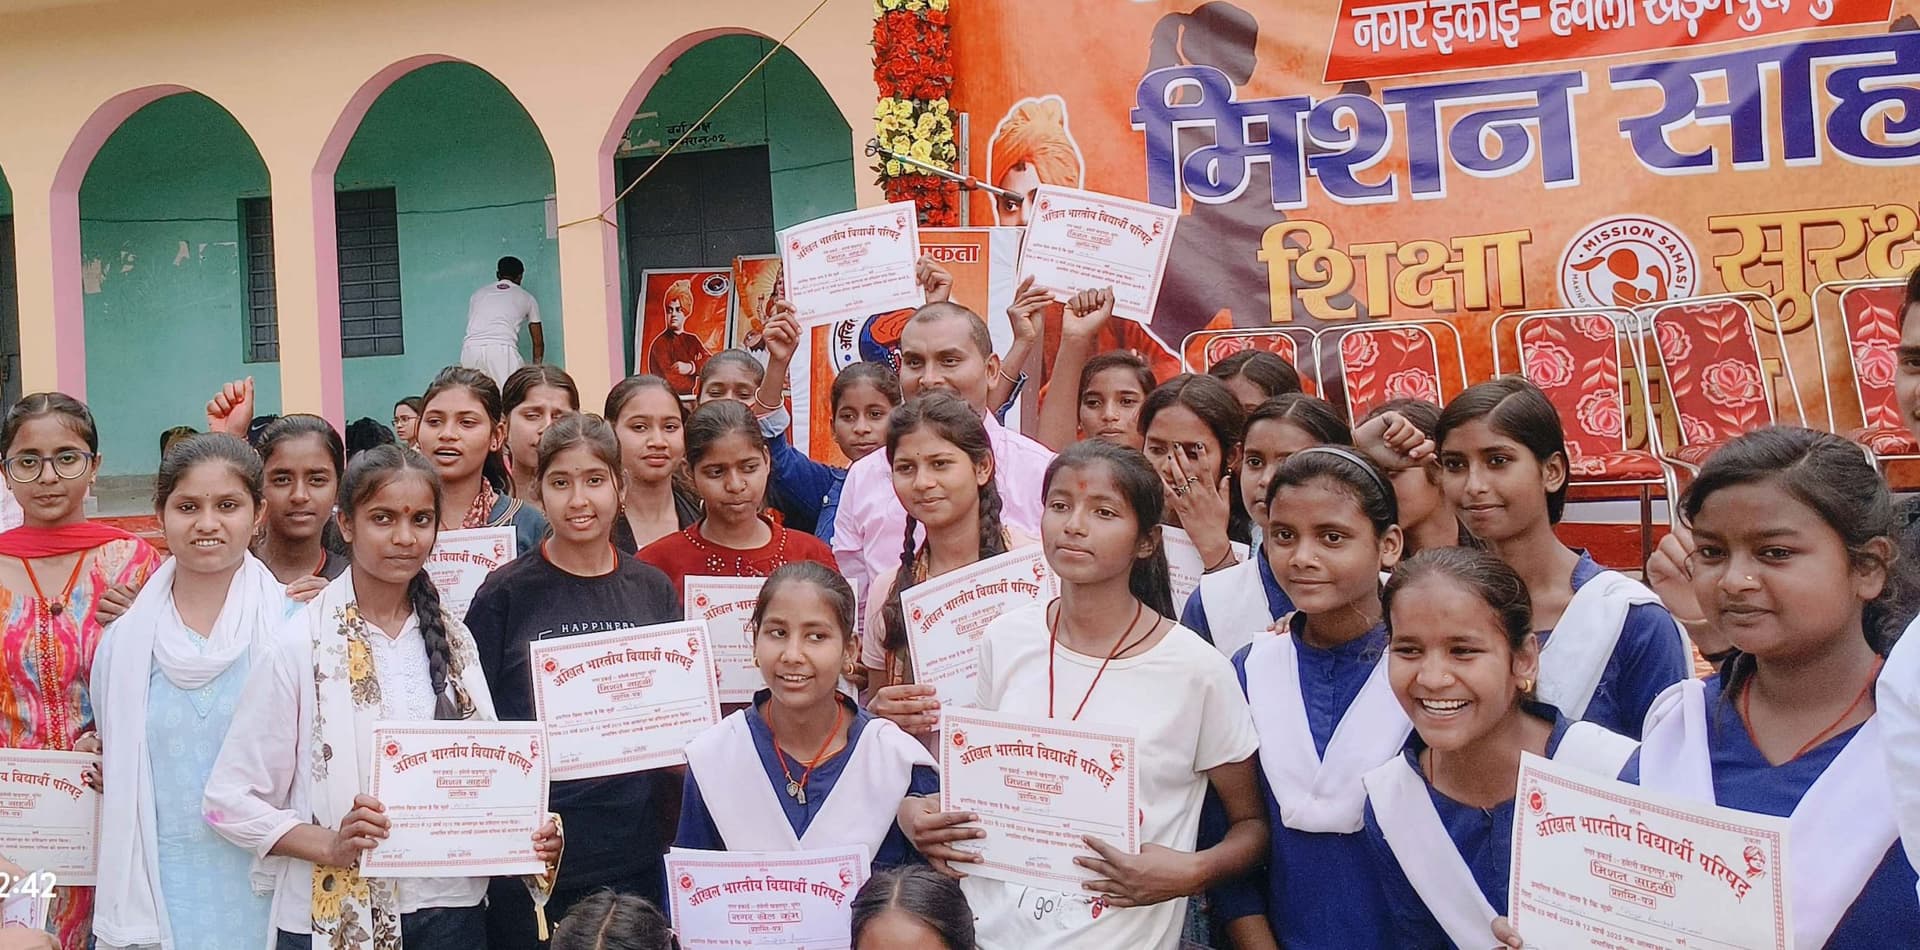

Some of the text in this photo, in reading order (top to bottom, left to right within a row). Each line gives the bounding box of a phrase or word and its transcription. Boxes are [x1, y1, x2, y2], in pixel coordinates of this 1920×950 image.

[1351, 1, 1427, 52] नगर
[1130, 31, 1920, 210] मिशन साह
[1257, 219, 1532, 322] शिक्षा
[1582, 226, 1687, 289] MISSION SAHASI
[393, 751, 427, 774] अखिल
[431, 743, 468, 761] भारतीय
[960, 746, 993, 766] अखिल
[995, 739, 1034, 758] भारतीय
[1037, 742, 1078, 768] विद्यार्थी
[1535, 812, 1752, 904] अखिल भारतीय विद्यार्थी परिषद्
[689, 886, 720, 906] अखिल
[724, 876, 763, 894] भारतीय
[766, 876, 807, 893] विद्यार्थी
